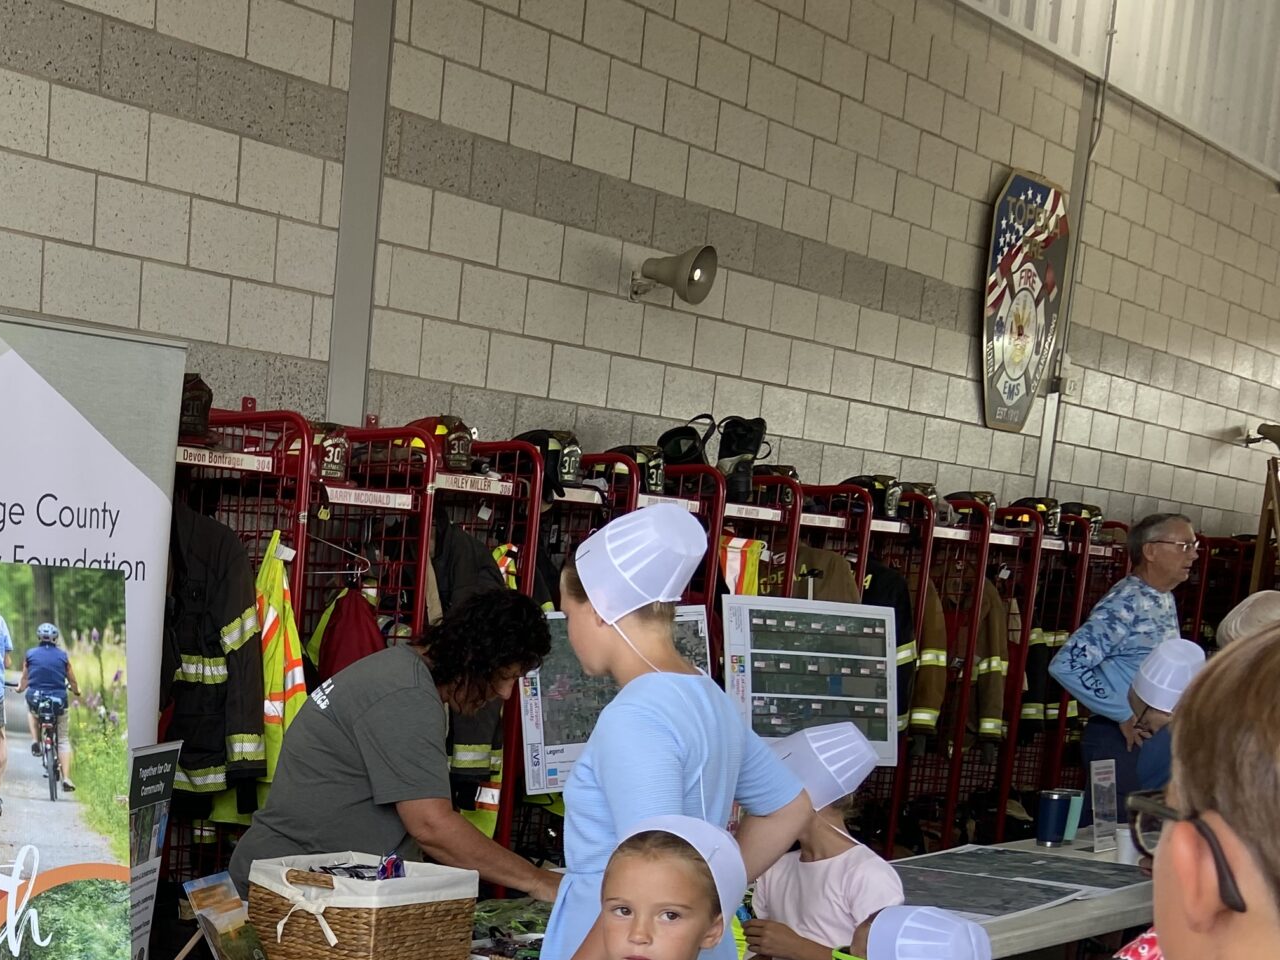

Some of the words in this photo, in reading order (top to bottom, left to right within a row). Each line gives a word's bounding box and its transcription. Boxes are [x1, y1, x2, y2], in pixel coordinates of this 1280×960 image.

[1020, 268, 1037, 291] FIRE
[1002, 382, 1020, 401] EMS
[324, 446, 341, 464] 30
[451, 440, 465, 454] 30
[183, 449, 206, 463] Devon
[208, 452, 244, 468] Bontrager
[256, 459, 270, 471] 304
[561, 456, 576, 473] 30
[445, 475, 468, 490] HARLEY
[470, 478, 491, 491] MILLER
[649, 468, 663, 485] 30
[330, 488, 352, 502] BARRY
[36, 493, 120, 538] County
[163, 762, 172, 774] Our
